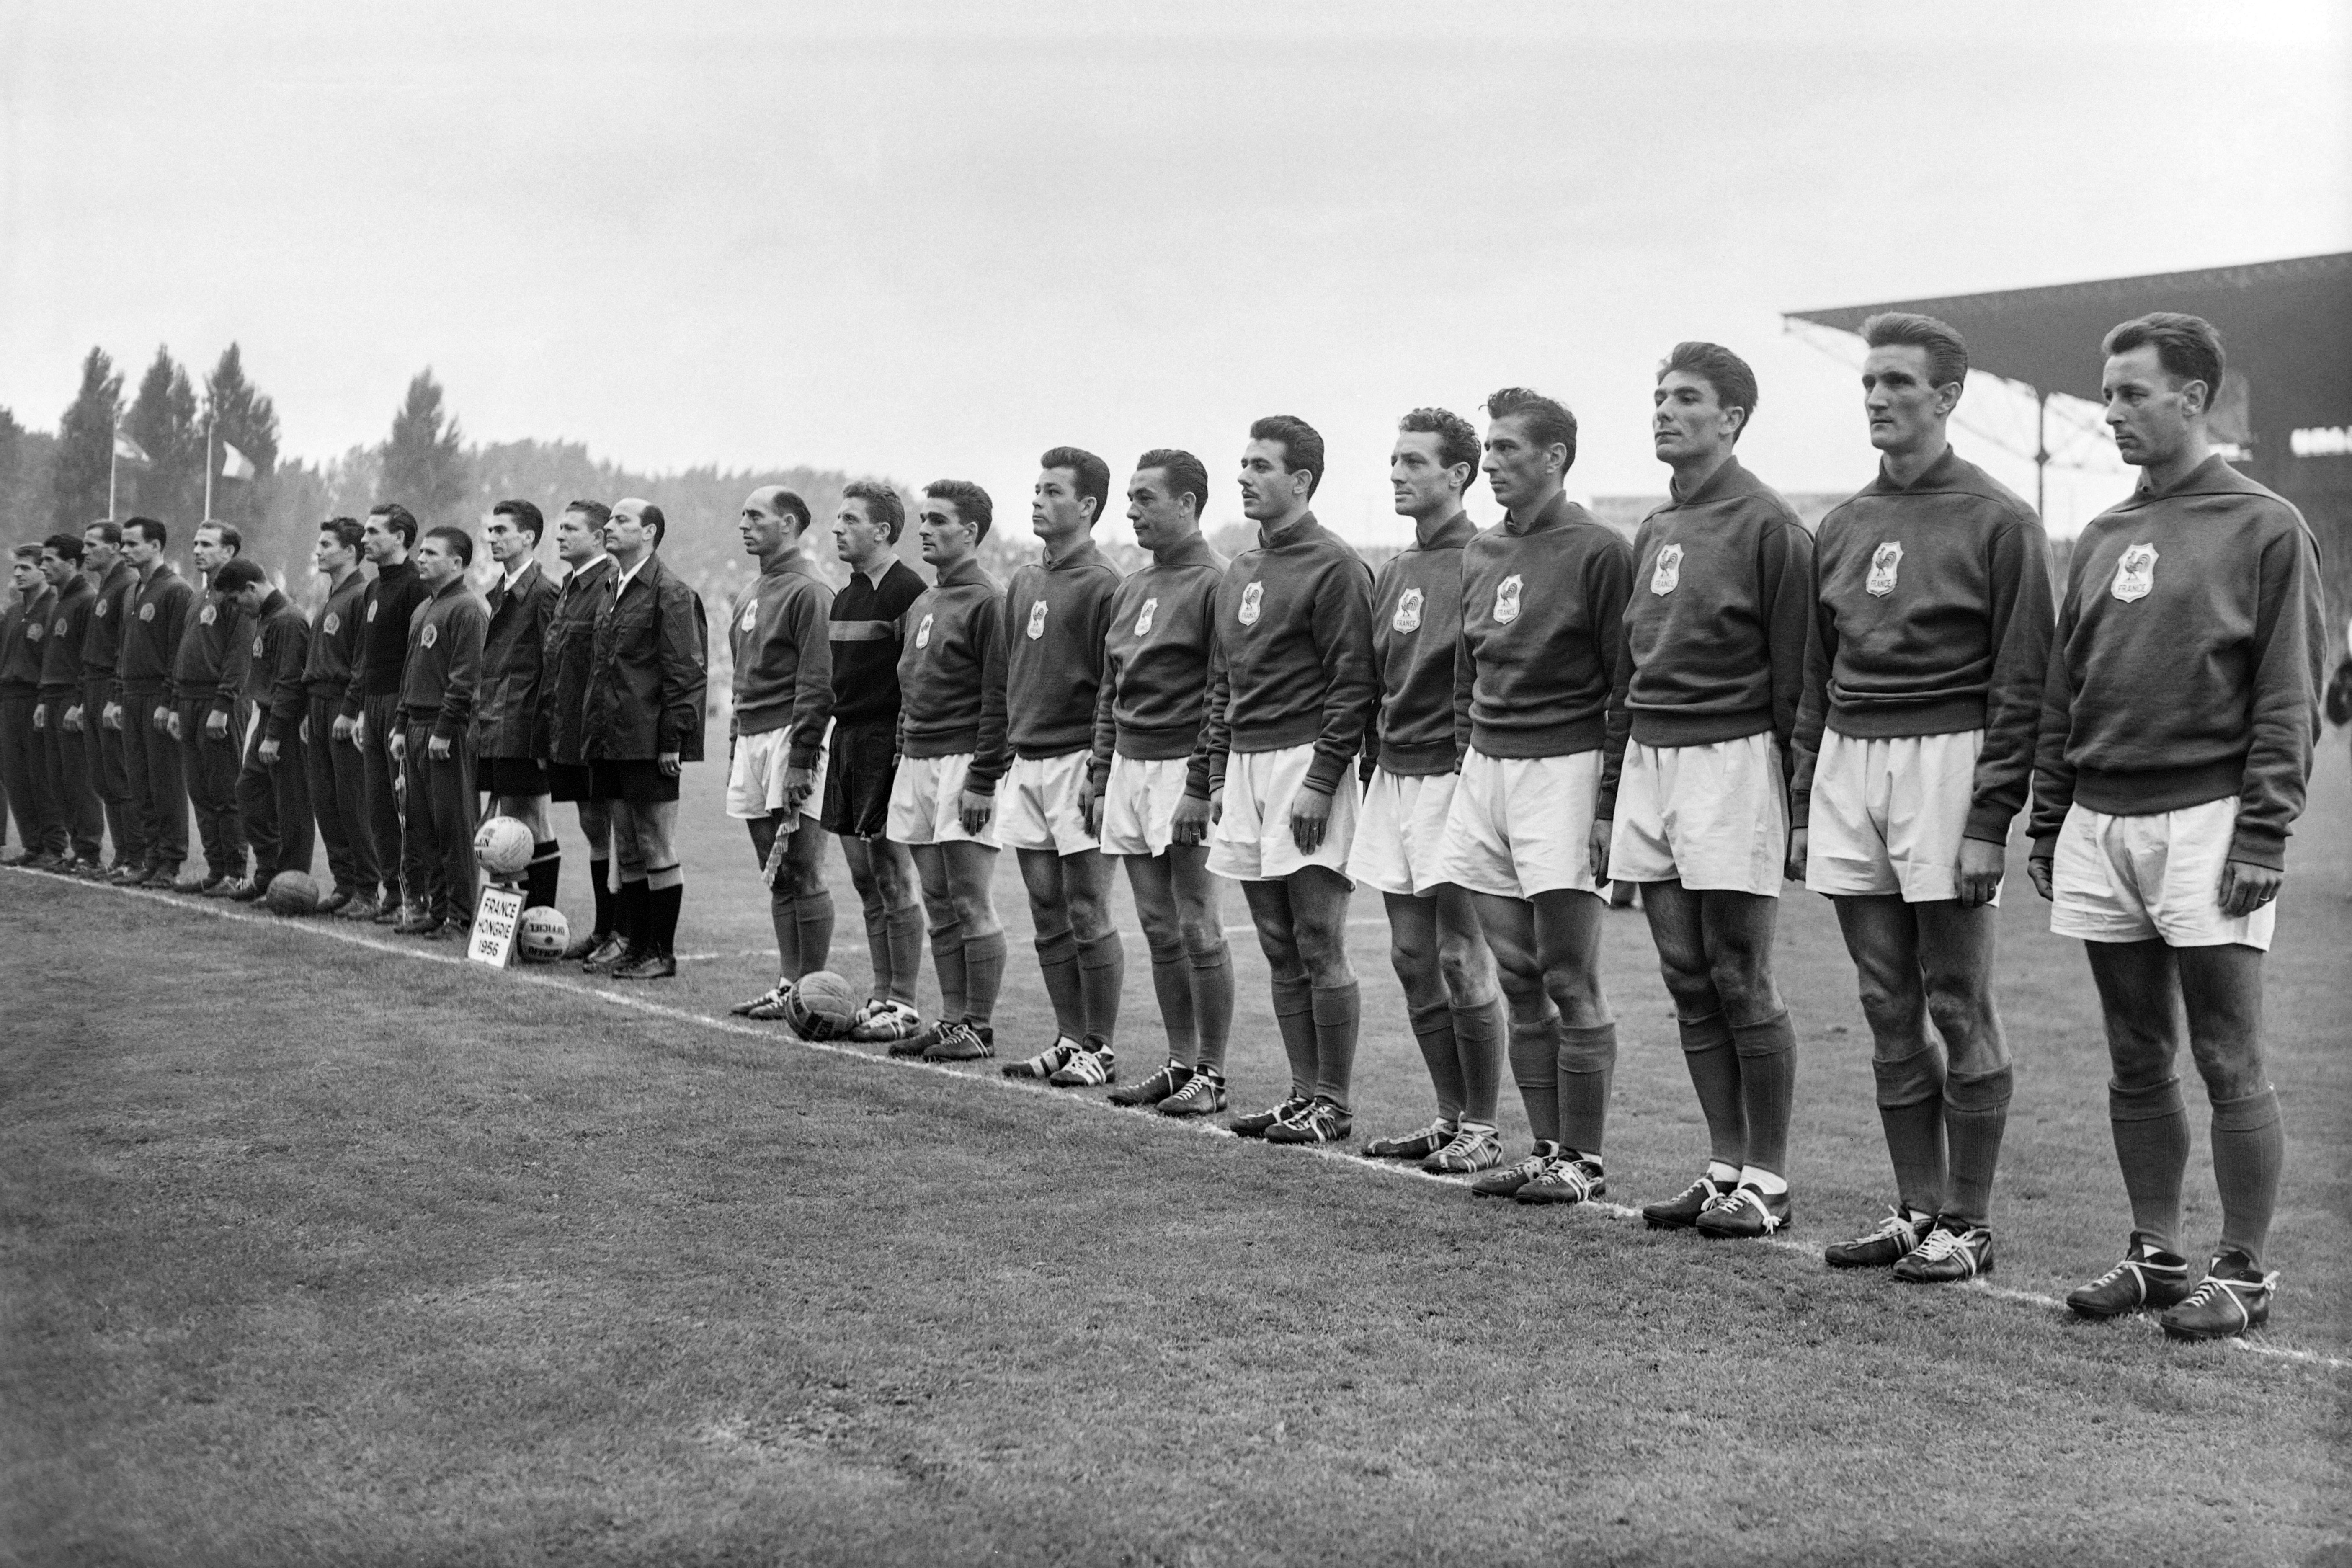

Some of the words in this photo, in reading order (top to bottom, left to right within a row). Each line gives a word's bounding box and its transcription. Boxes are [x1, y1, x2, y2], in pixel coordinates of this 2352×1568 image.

[1871, 579, 1891, 588] FRANCE
[2118, 584, 2146, 592] FRANCE
[483, 898, 516, 918] FRANCE
[476, 919, 511, 939] HONGRIE
[478, 939, 499, 956] 1956
